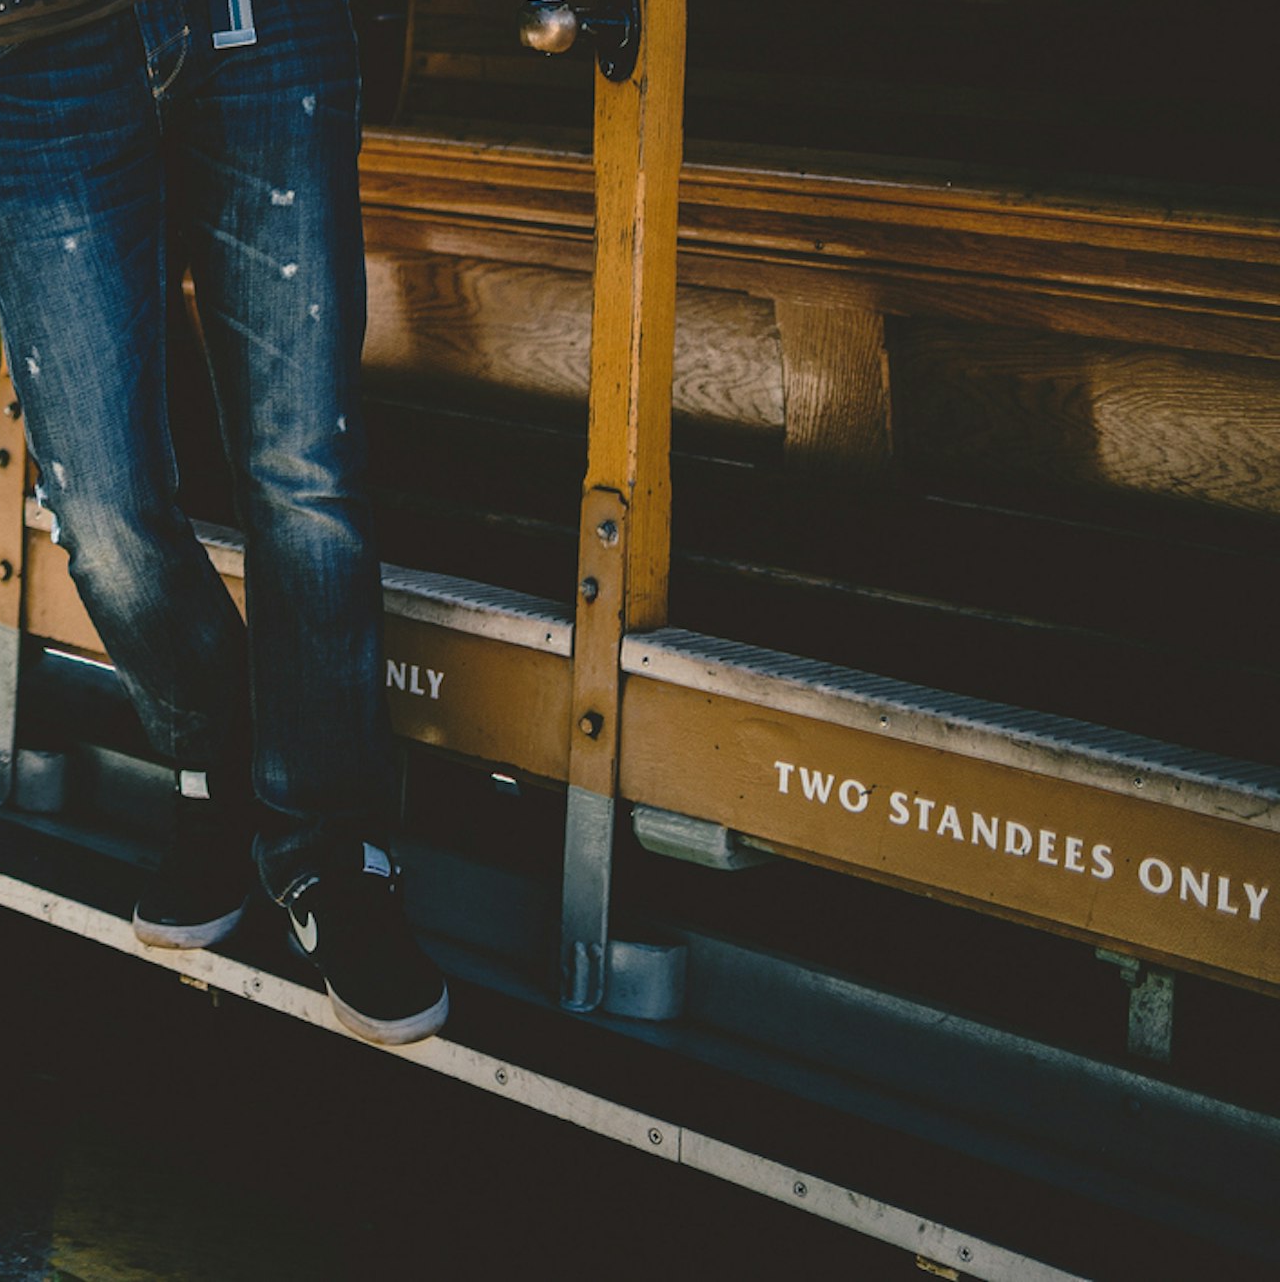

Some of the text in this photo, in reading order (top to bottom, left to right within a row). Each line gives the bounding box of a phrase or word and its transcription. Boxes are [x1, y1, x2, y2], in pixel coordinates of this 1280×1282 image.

[385, 659, 445, 700] NLY
[774, 760, 1270, 921] TWO STANDEES ONLY
